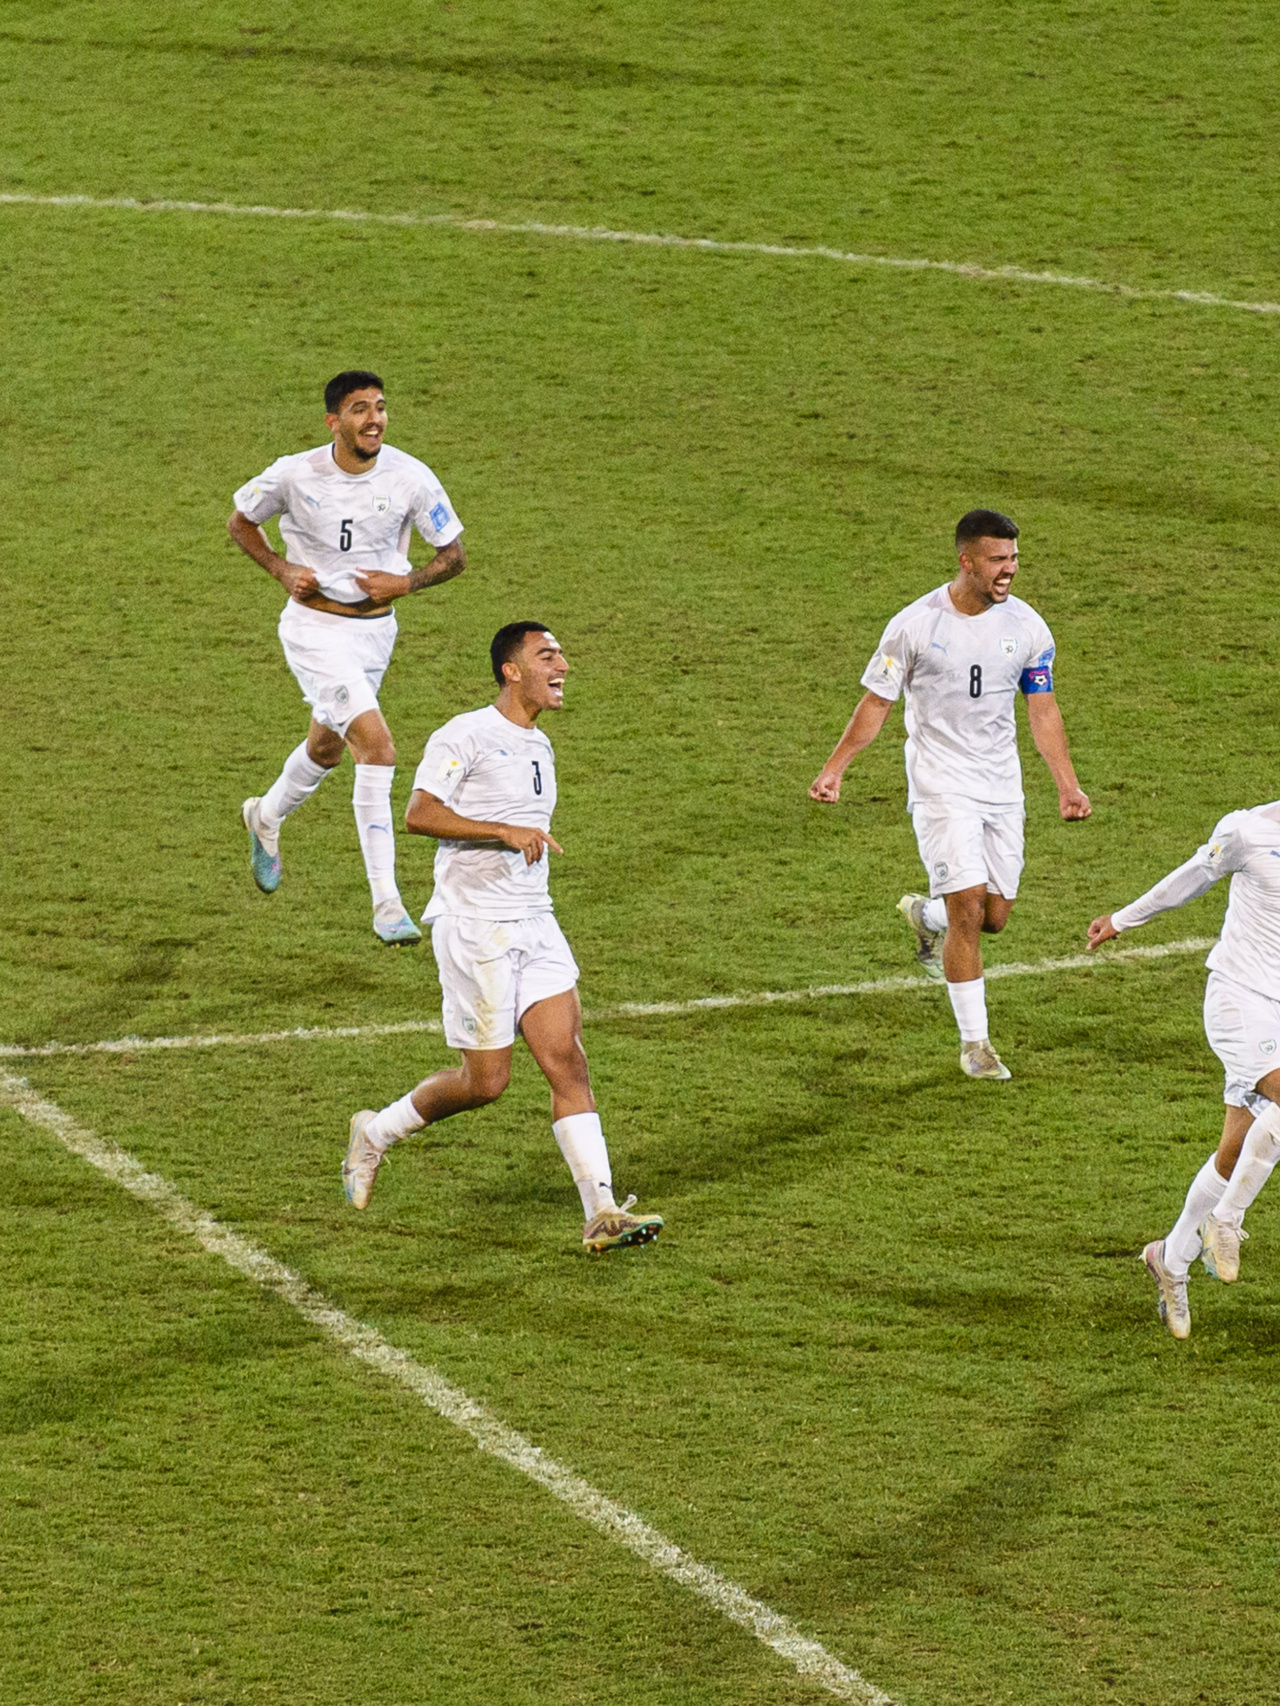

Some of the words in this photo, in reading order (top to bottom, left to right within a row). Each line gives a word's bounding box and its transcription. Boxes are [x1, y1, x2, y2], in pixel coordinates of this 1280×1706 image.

[340, 519, 353, 552] 5
[970, 664, 982, 698] 8
[531, 760, 542, 796] 3
